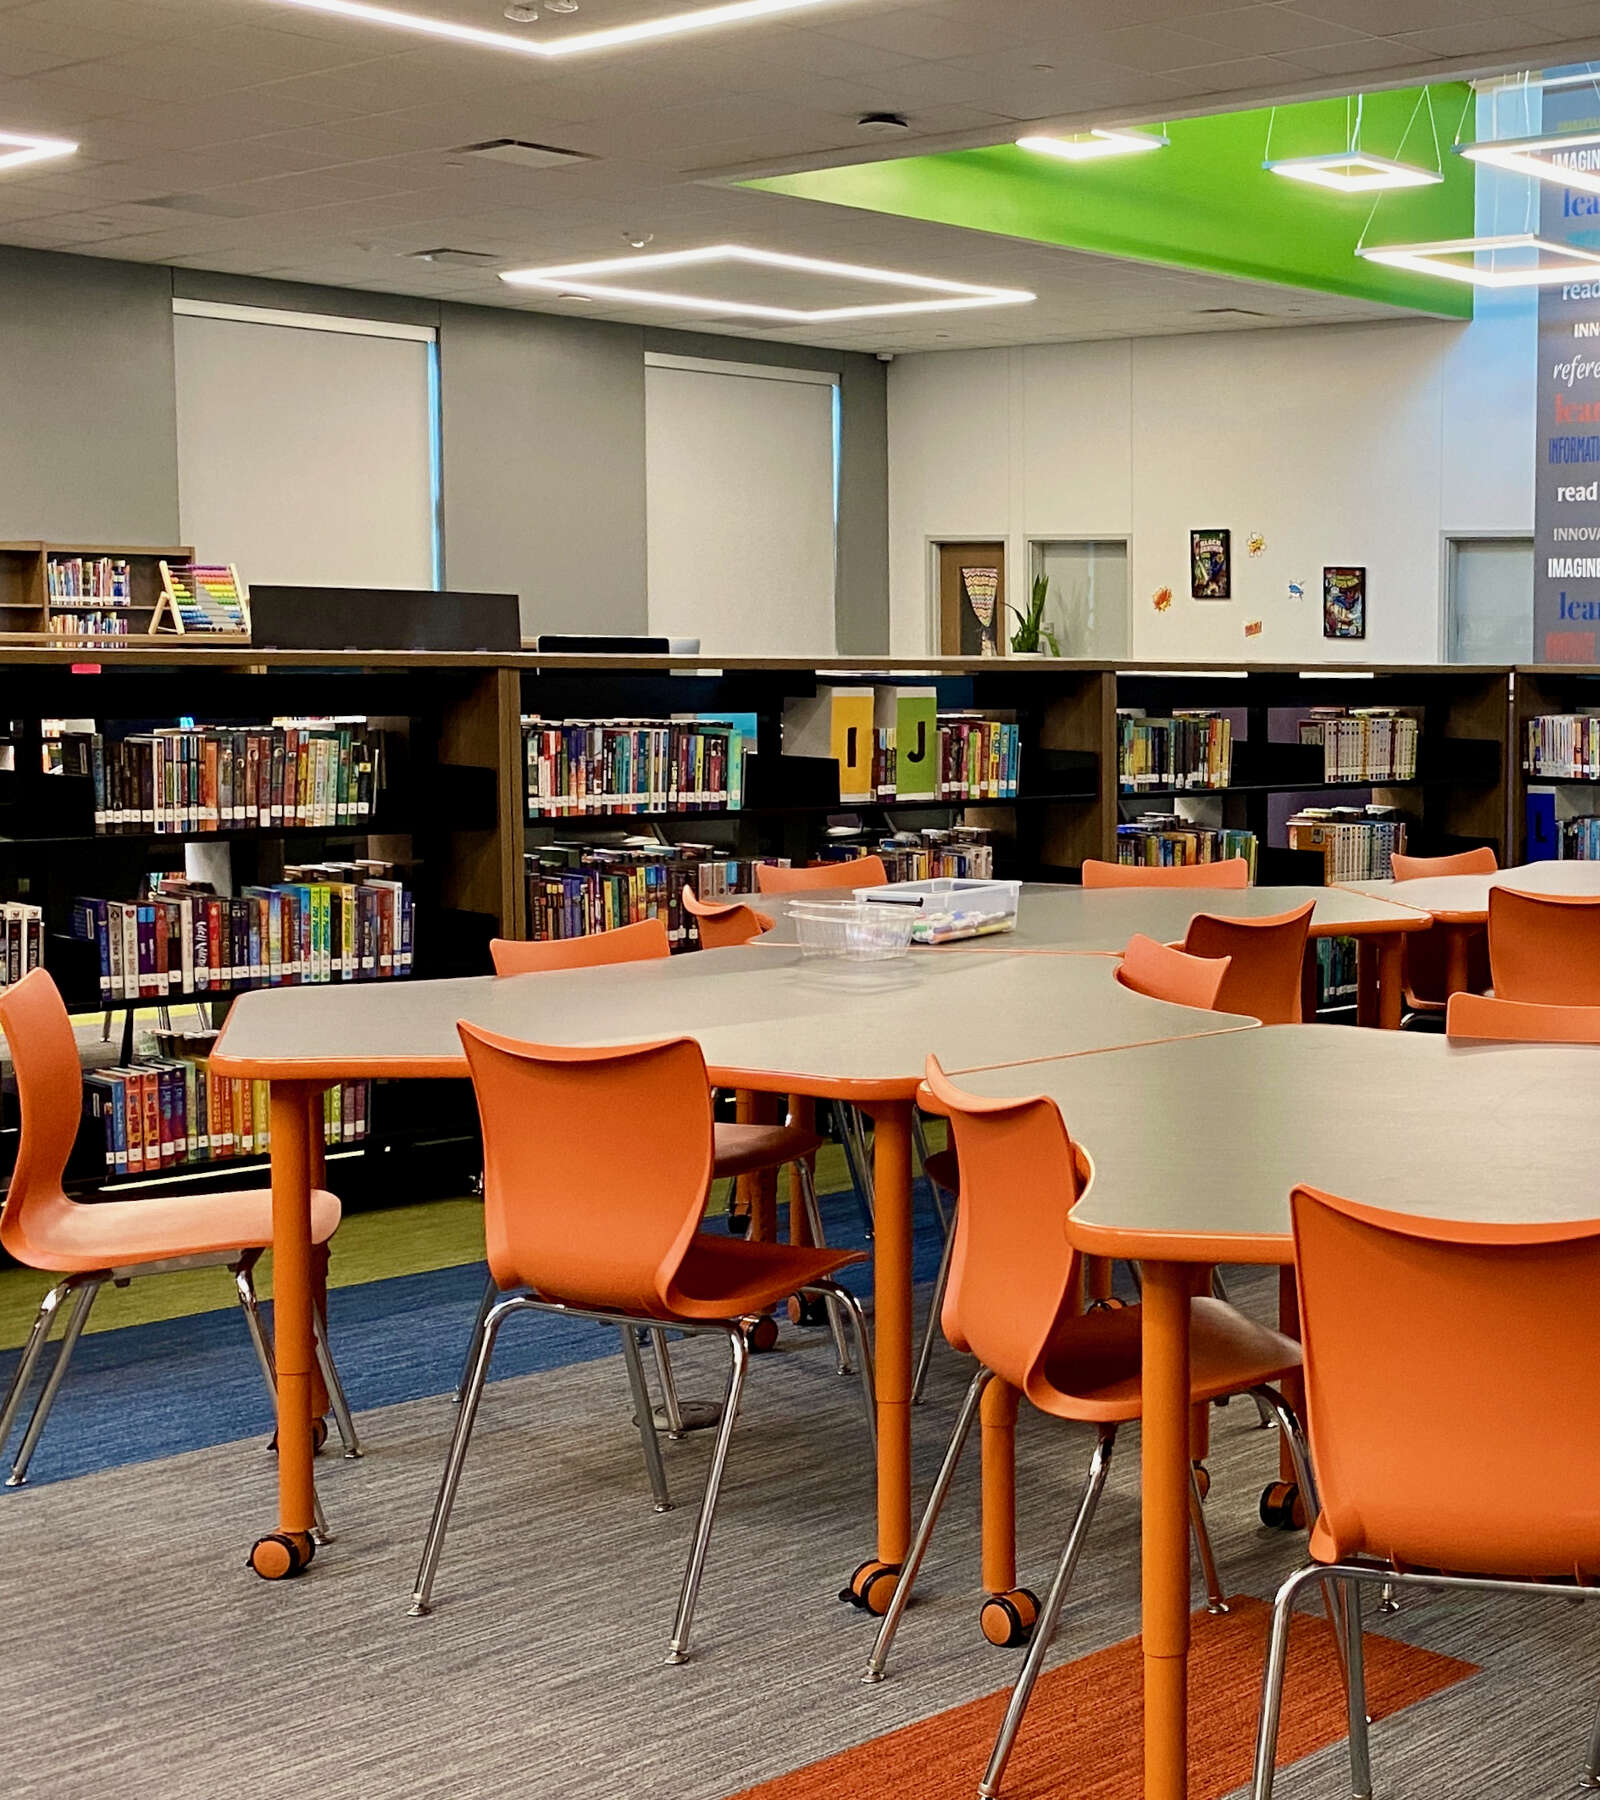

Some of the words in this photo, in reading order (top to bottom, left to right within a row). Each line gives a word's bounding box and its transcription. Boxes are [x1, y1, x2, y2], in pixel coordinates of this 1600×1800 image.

[1557, 481, 1598, 502] read
[847, 727, 857, 767] I
[907, 721, 925, 763] J
